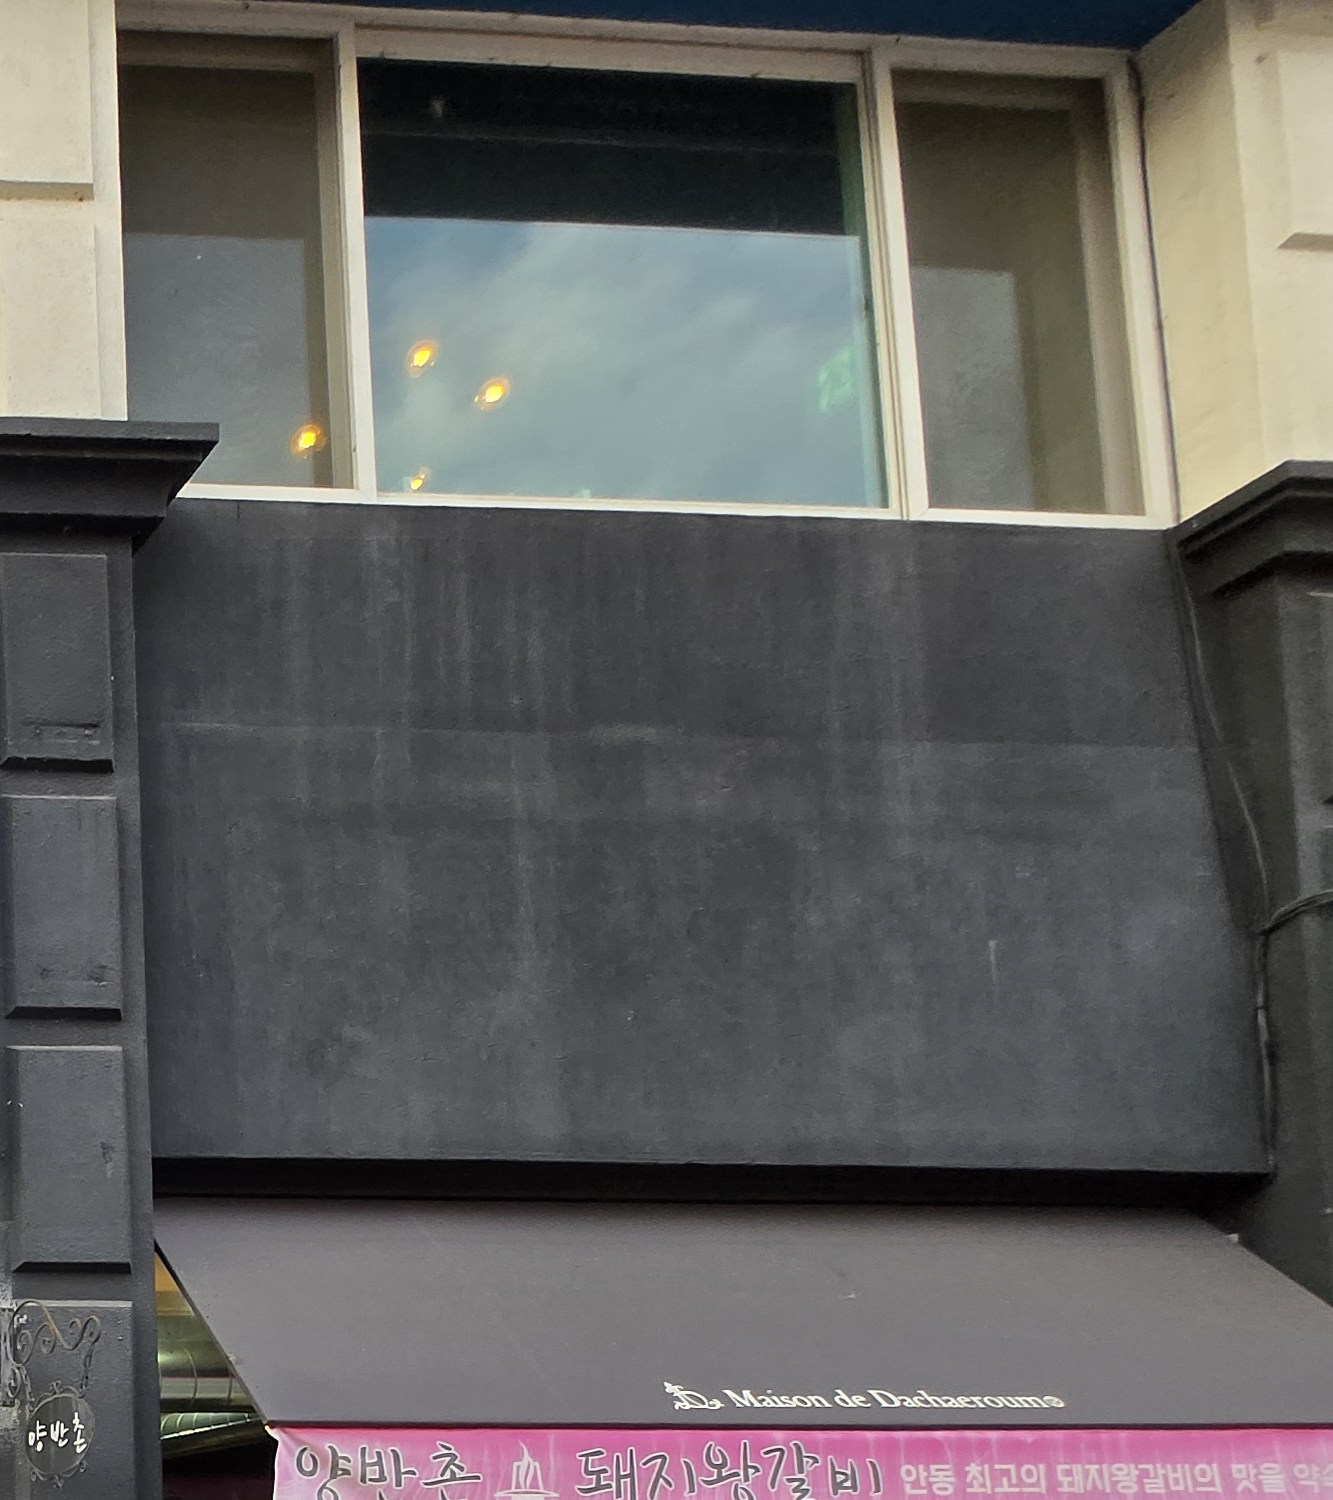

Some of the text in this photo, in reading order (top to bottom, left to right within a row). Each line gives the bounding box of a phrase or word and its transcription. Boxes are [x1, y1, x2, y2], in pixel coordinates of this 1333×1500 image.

[724, 1390, 833, 1408] Maison
[834, 1390, 871, 1408] de
[28, 1412, 88, 1454] 양반촌
[899, 1464, 955, 1495] 안동
[965, 1463, 1047, 1494] 최고의
[1057, 1463, 1222, 1493] 돼지왕갈비의
[1231, 1463, 1286, 1493] 맛을
